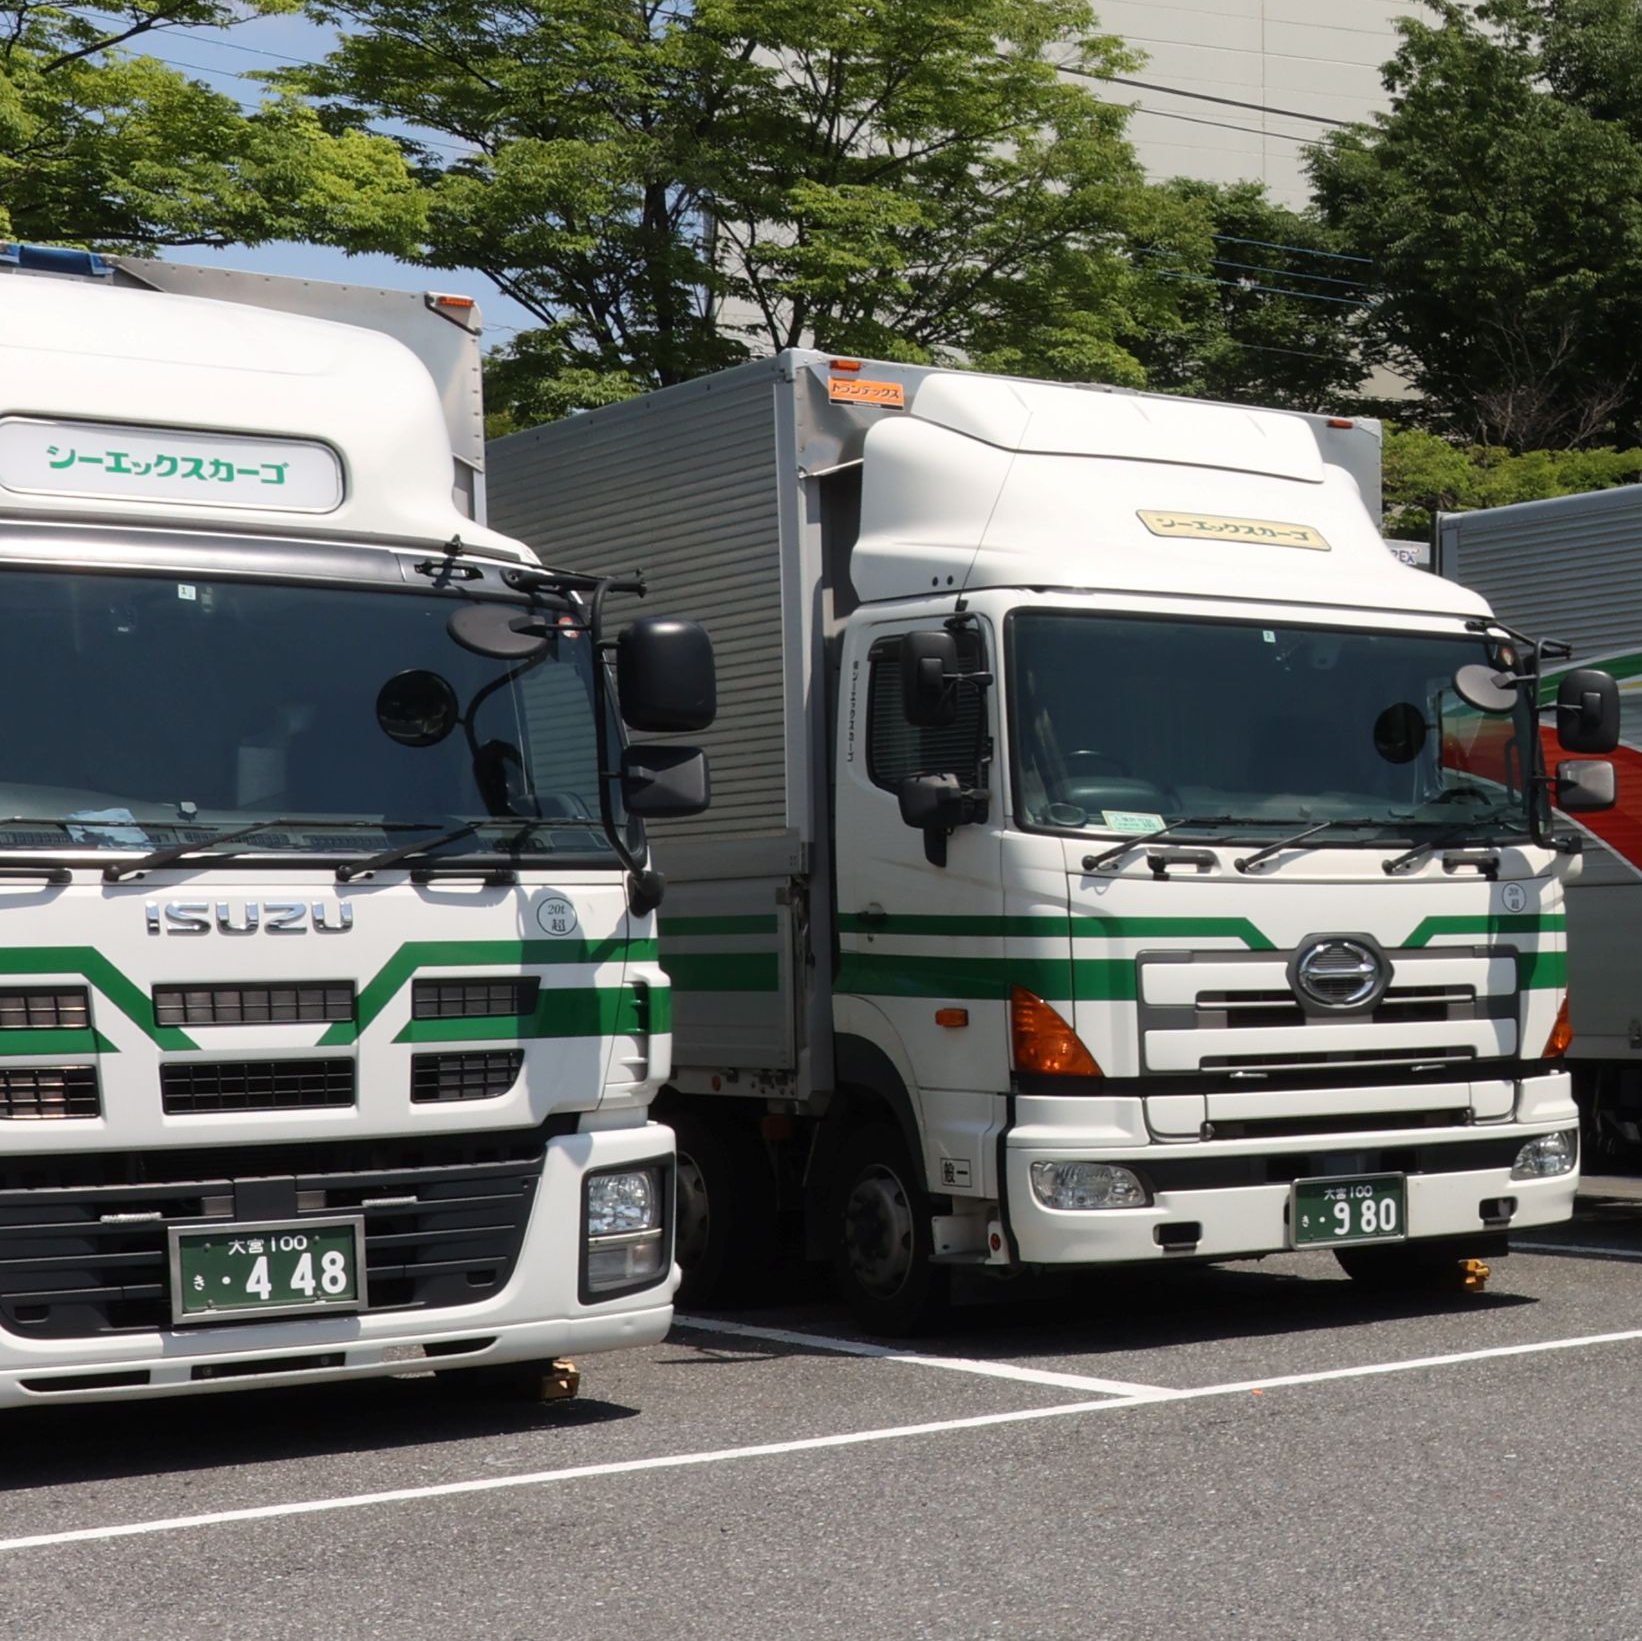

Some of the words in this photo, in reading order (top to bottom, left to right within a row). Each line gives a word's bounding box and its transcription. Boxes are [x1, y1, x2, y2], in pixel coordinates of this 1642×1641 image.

[831, 382, 900, 399] トランテックス
[46, 445, 291, 485] シーエックスカーゴ
[1155, 517, 1310, 542] シーエックスカーゴ
[145, 901, 353, 936] ISUZU
[193, 1274, 205, 1291] き
